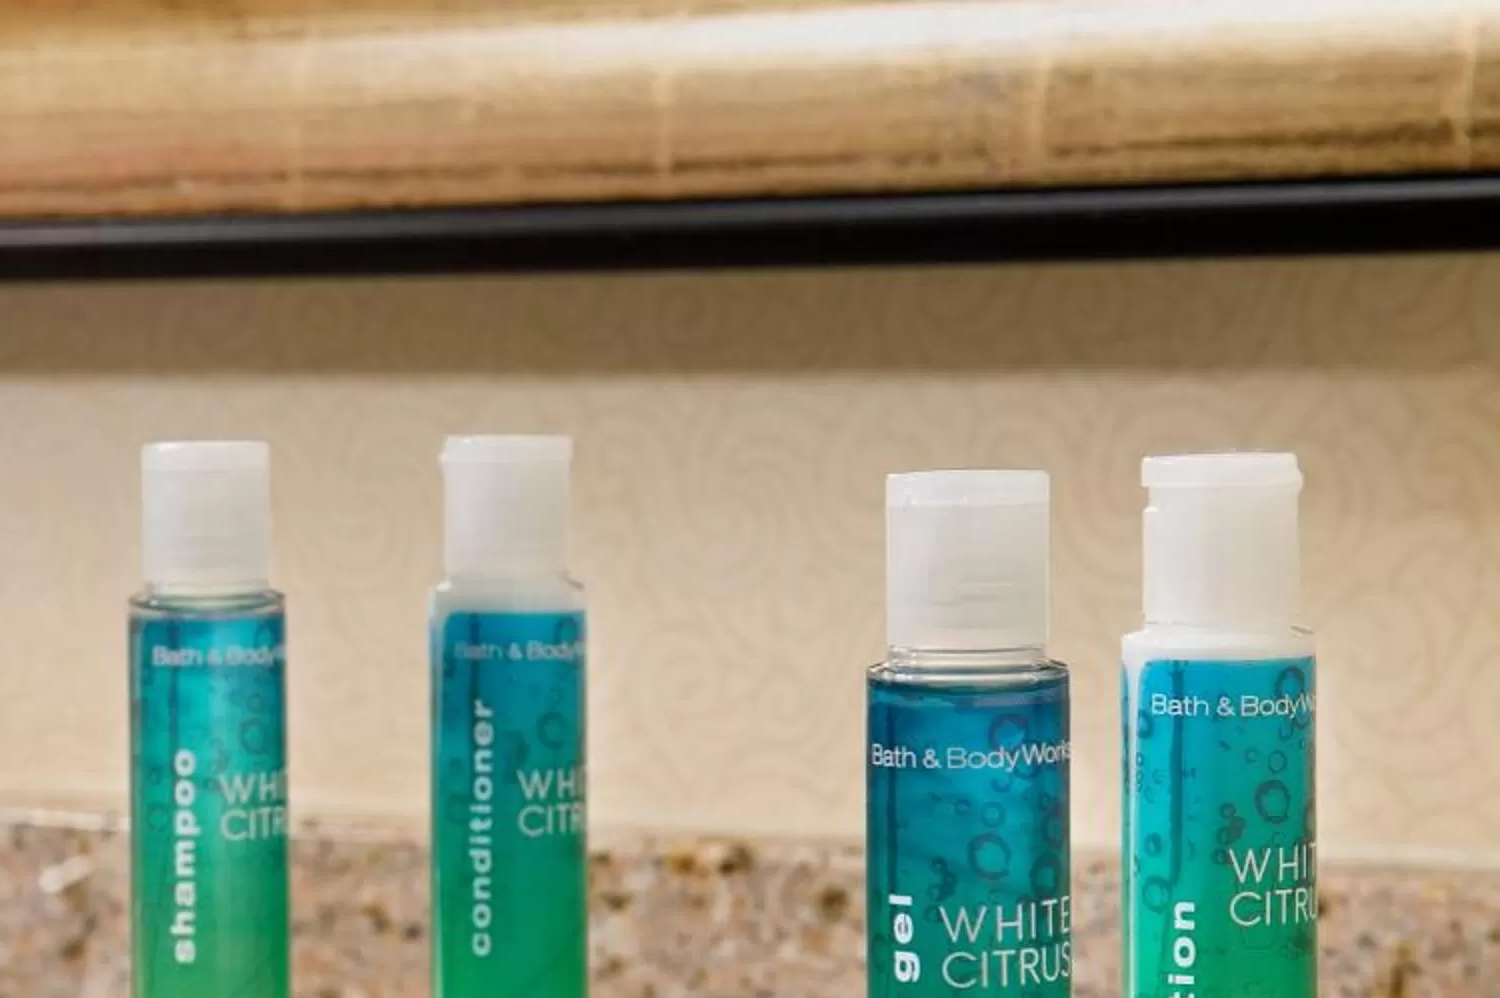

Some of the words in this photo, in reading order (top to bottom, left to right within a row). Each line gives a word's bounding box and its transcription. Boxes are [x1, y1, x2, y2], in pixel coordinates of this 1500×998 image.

[1151, 693, 1209, 717] Bath
[1216, 696, 1236, 717] &
[871, 743, 917, 768] Bath
[922, 748, 942, 769] &
[469, 699, 495, 957] conditioner
[170, 748, 201, 965] shampoo
[889, 894, 921, 983] gel
[938, 895, 1071, 943] WHITE
[942, 940, 1071, 989] CITRUS
